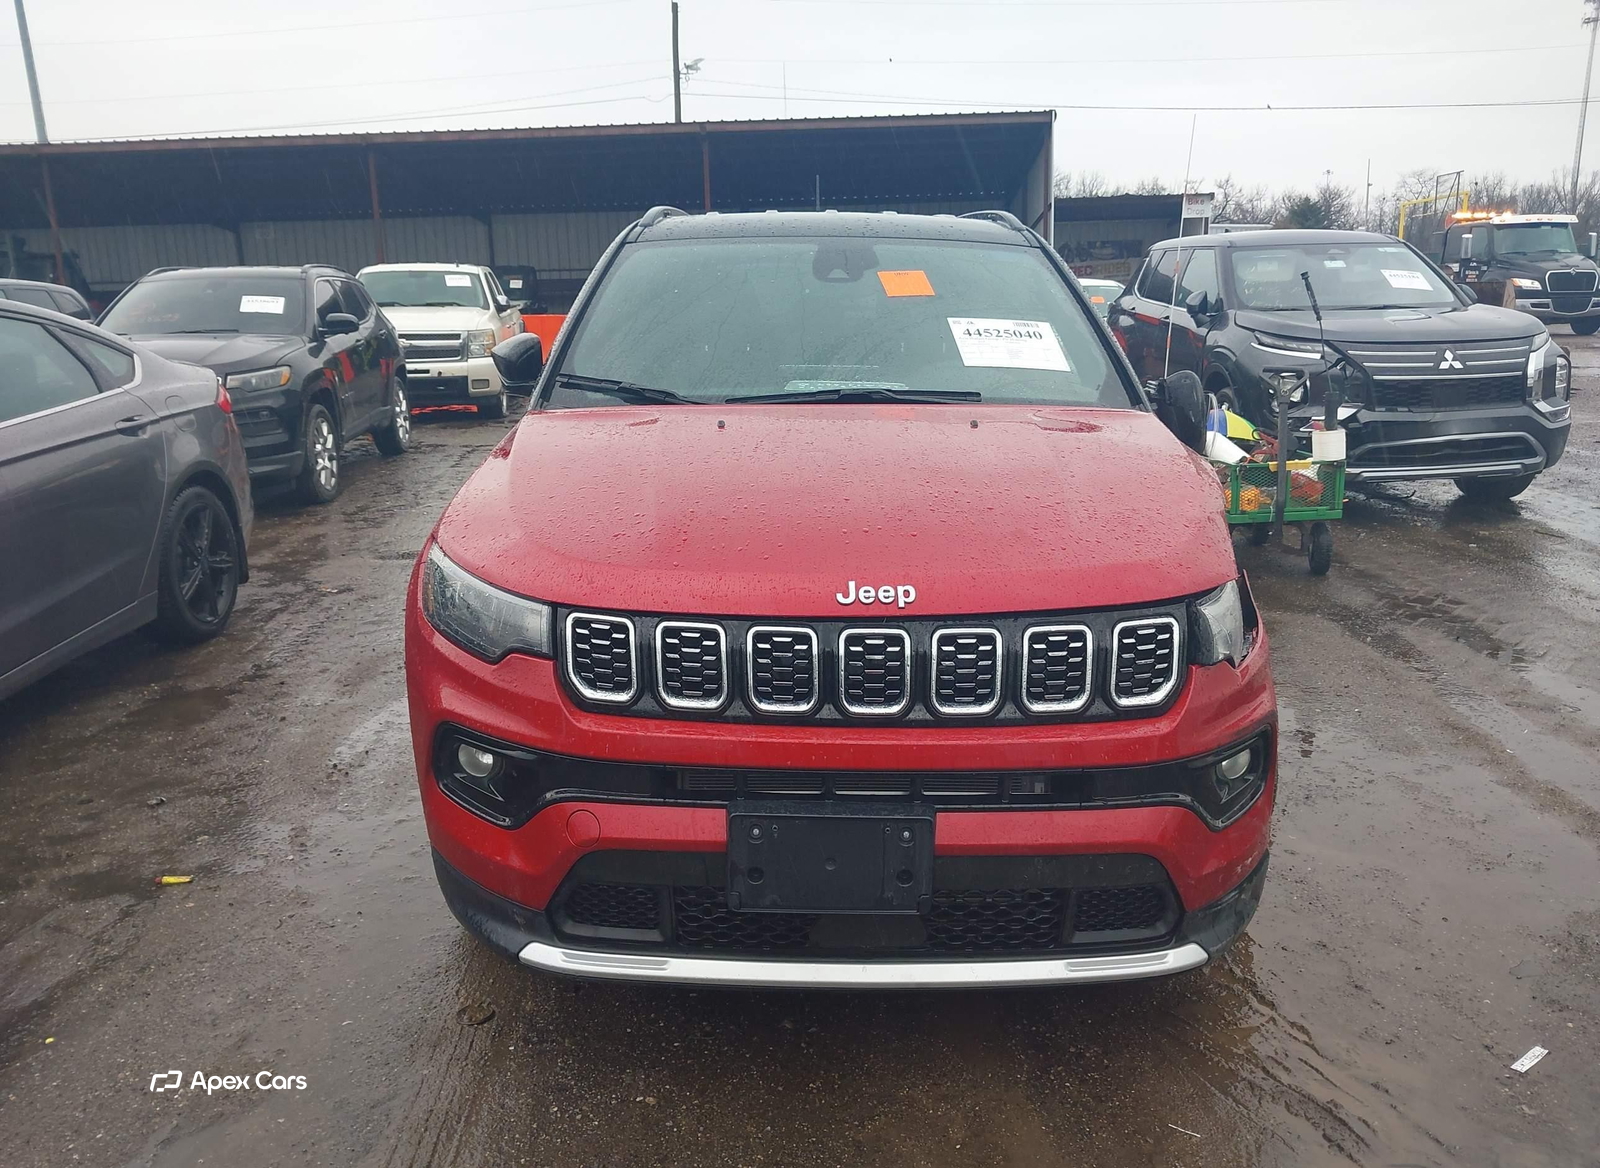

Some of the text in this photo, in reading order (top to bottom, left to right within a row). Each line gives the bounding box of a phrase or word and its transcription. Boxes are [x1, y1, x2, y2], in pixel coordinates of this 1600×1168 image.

[1187, 198, 1205, 206] Bike
[1187, 207, 1205, 216] Drop
[962, 328, 1043, 340] 44525040
[835, 580, 917, 608] Jeep
